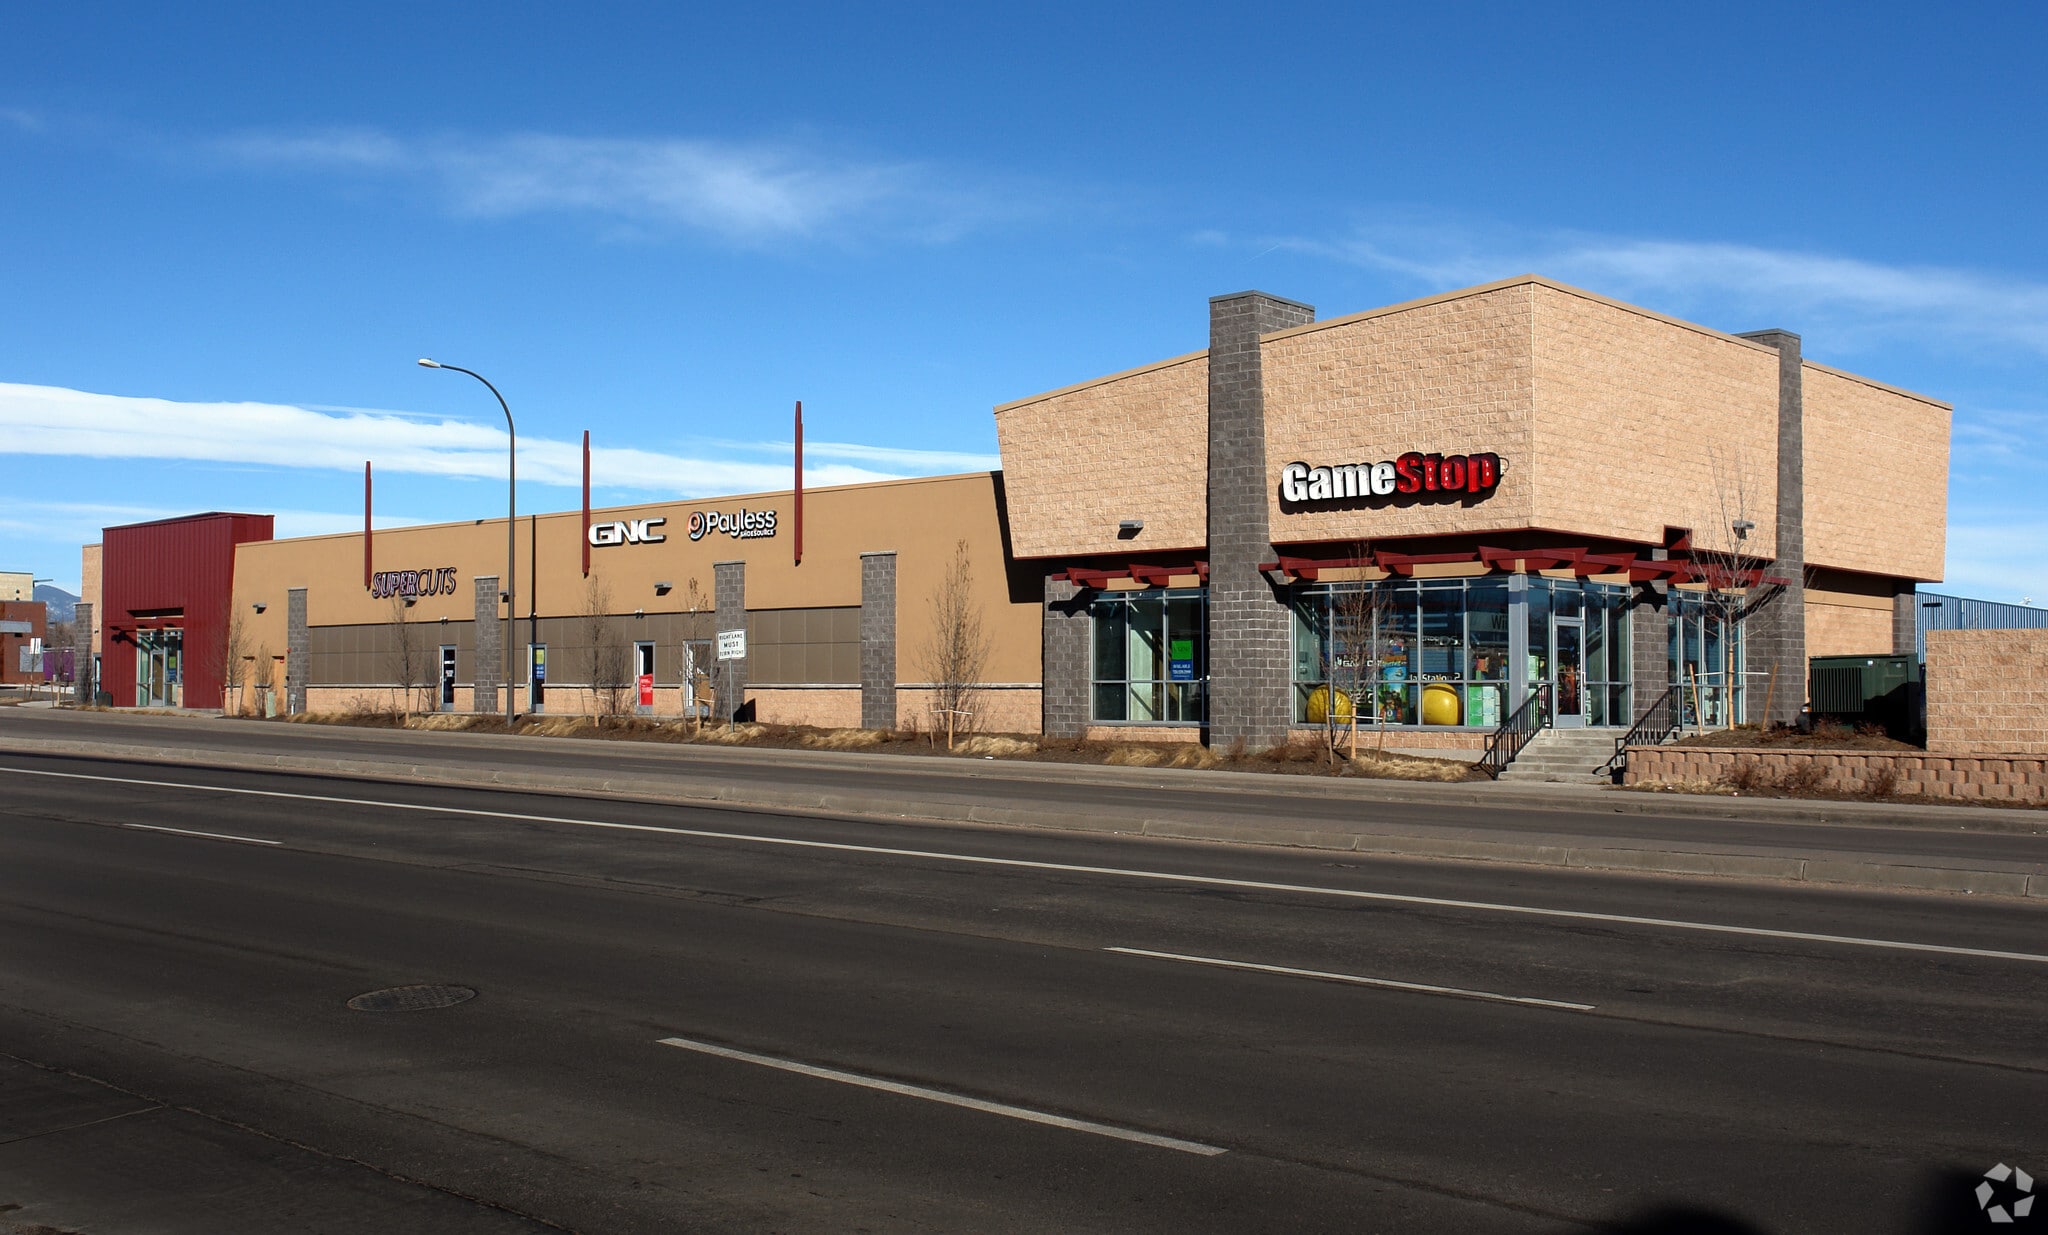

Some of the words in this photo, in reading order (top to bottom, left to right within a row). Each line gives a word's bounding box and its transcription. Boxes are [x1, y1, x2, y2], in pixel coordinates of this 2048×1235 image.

[1282, 452, 1497, 502] GameStop
[588, 517, 667, 546] GNC
[706, 509, 776, 537] Payless
[372, 567, 457, 599] SUPERCUTS
